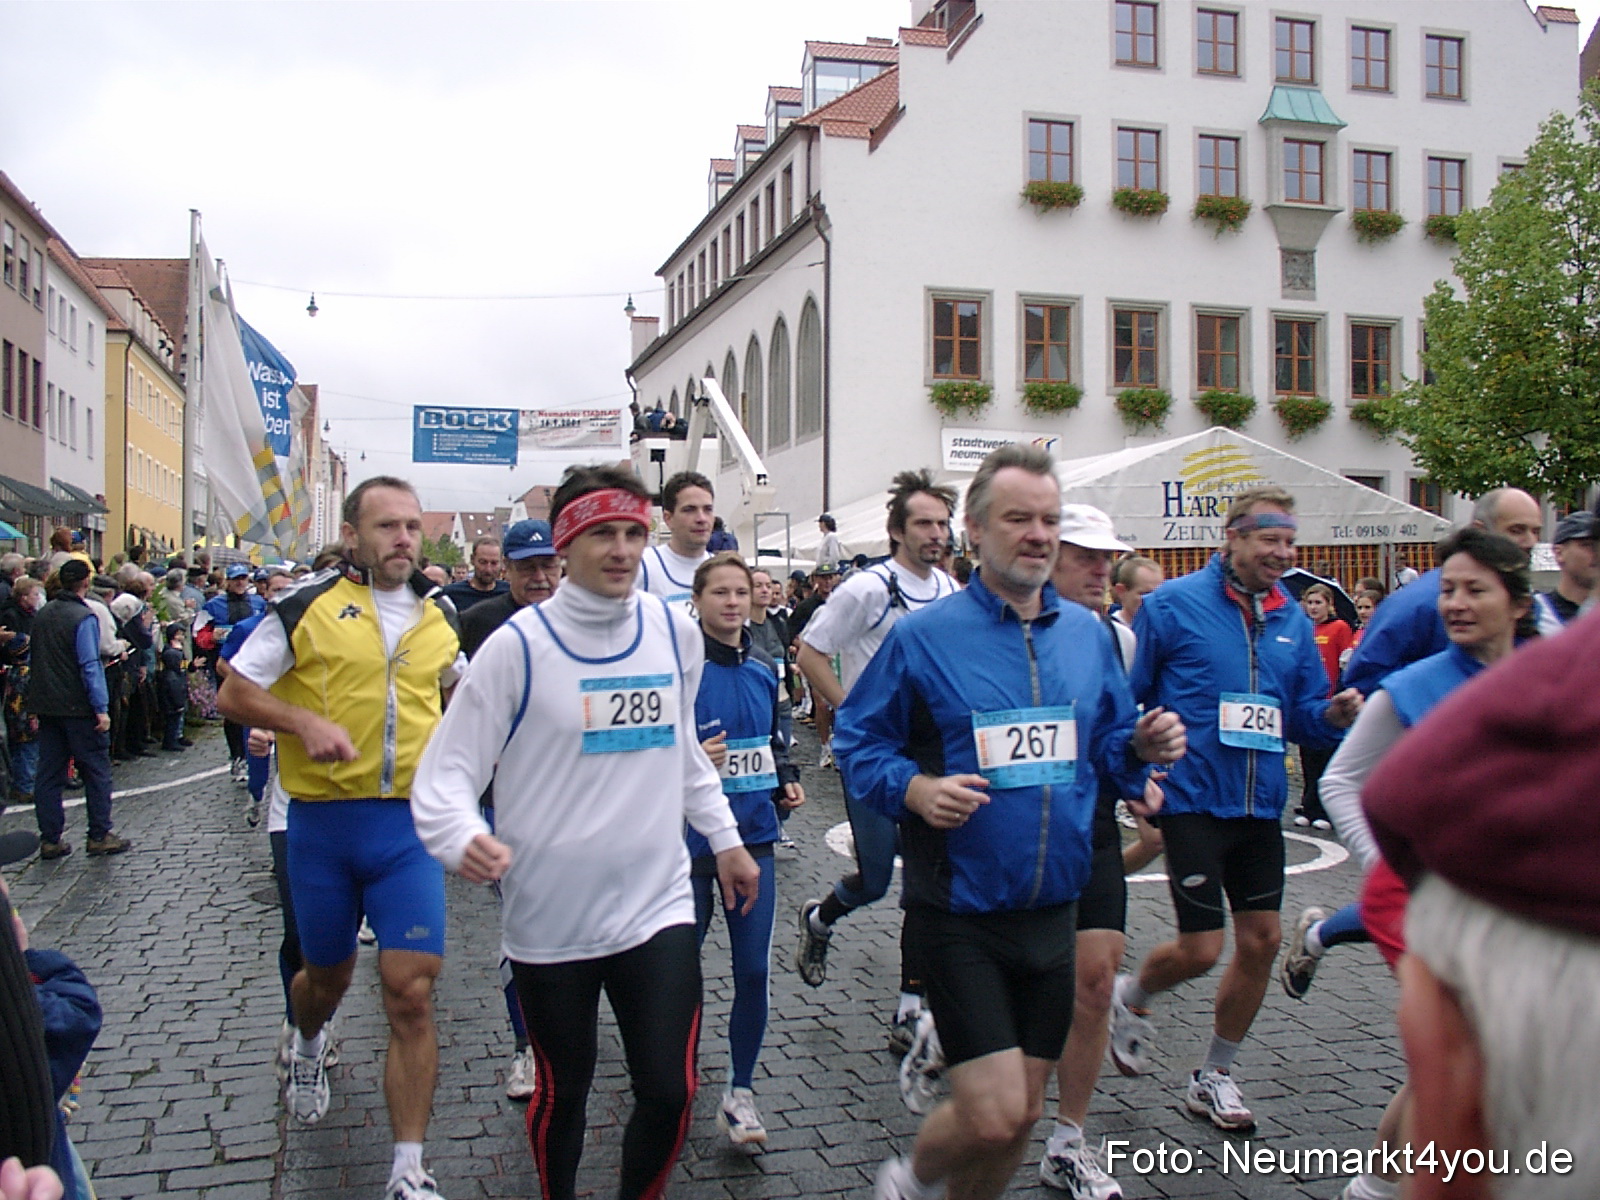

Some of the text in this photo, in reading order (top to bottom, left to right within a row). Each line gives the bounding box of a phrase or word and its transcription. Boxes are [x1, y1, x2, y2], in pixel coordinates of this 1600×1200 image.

[262, 387, 281, 409] ist
[263, 413, 291, 435] ben
[420, 408, 513, 432] BOCK
[950, 449, 987, 460] neuma
[1162, 481, 1234, 518] HÄRT
[1163, 522, 1227, 541] ZELTVE
[1331, 525, 1353, 538] Tel:
[1356, 525, 1389, 538] 09180
[1399, 523, 1418, 537] 402
[685, 601, 698, 619] 2
[610, 691, 661, 726] 289
[1241, 705, 1275, 733] 264
[1006, 724, 1058, 760] 267
[728, 751, 762, 776] 510
